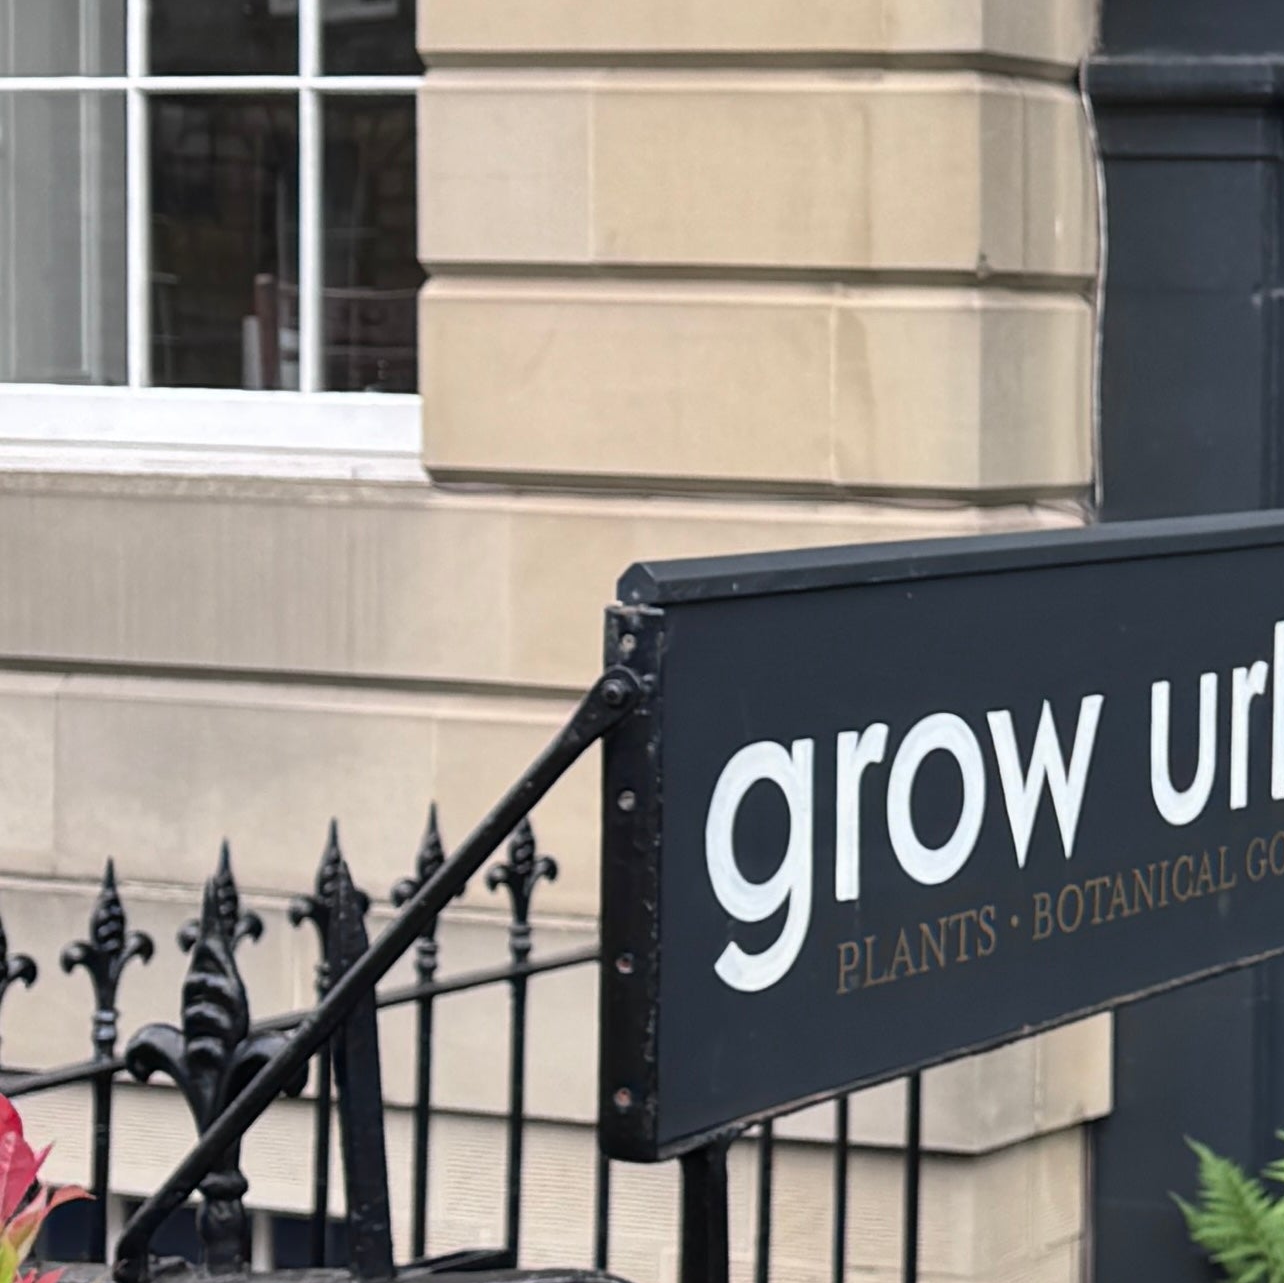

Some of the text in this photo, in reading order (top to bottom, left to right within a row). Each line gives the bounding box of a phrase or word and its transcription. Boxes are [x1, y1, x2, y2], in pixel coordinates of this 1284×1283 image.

[704, 693, 1105, 994] grow
[836, 909, 998, 995] PLANTS
[1032, 849, 1238, 941] BOTANICAL
